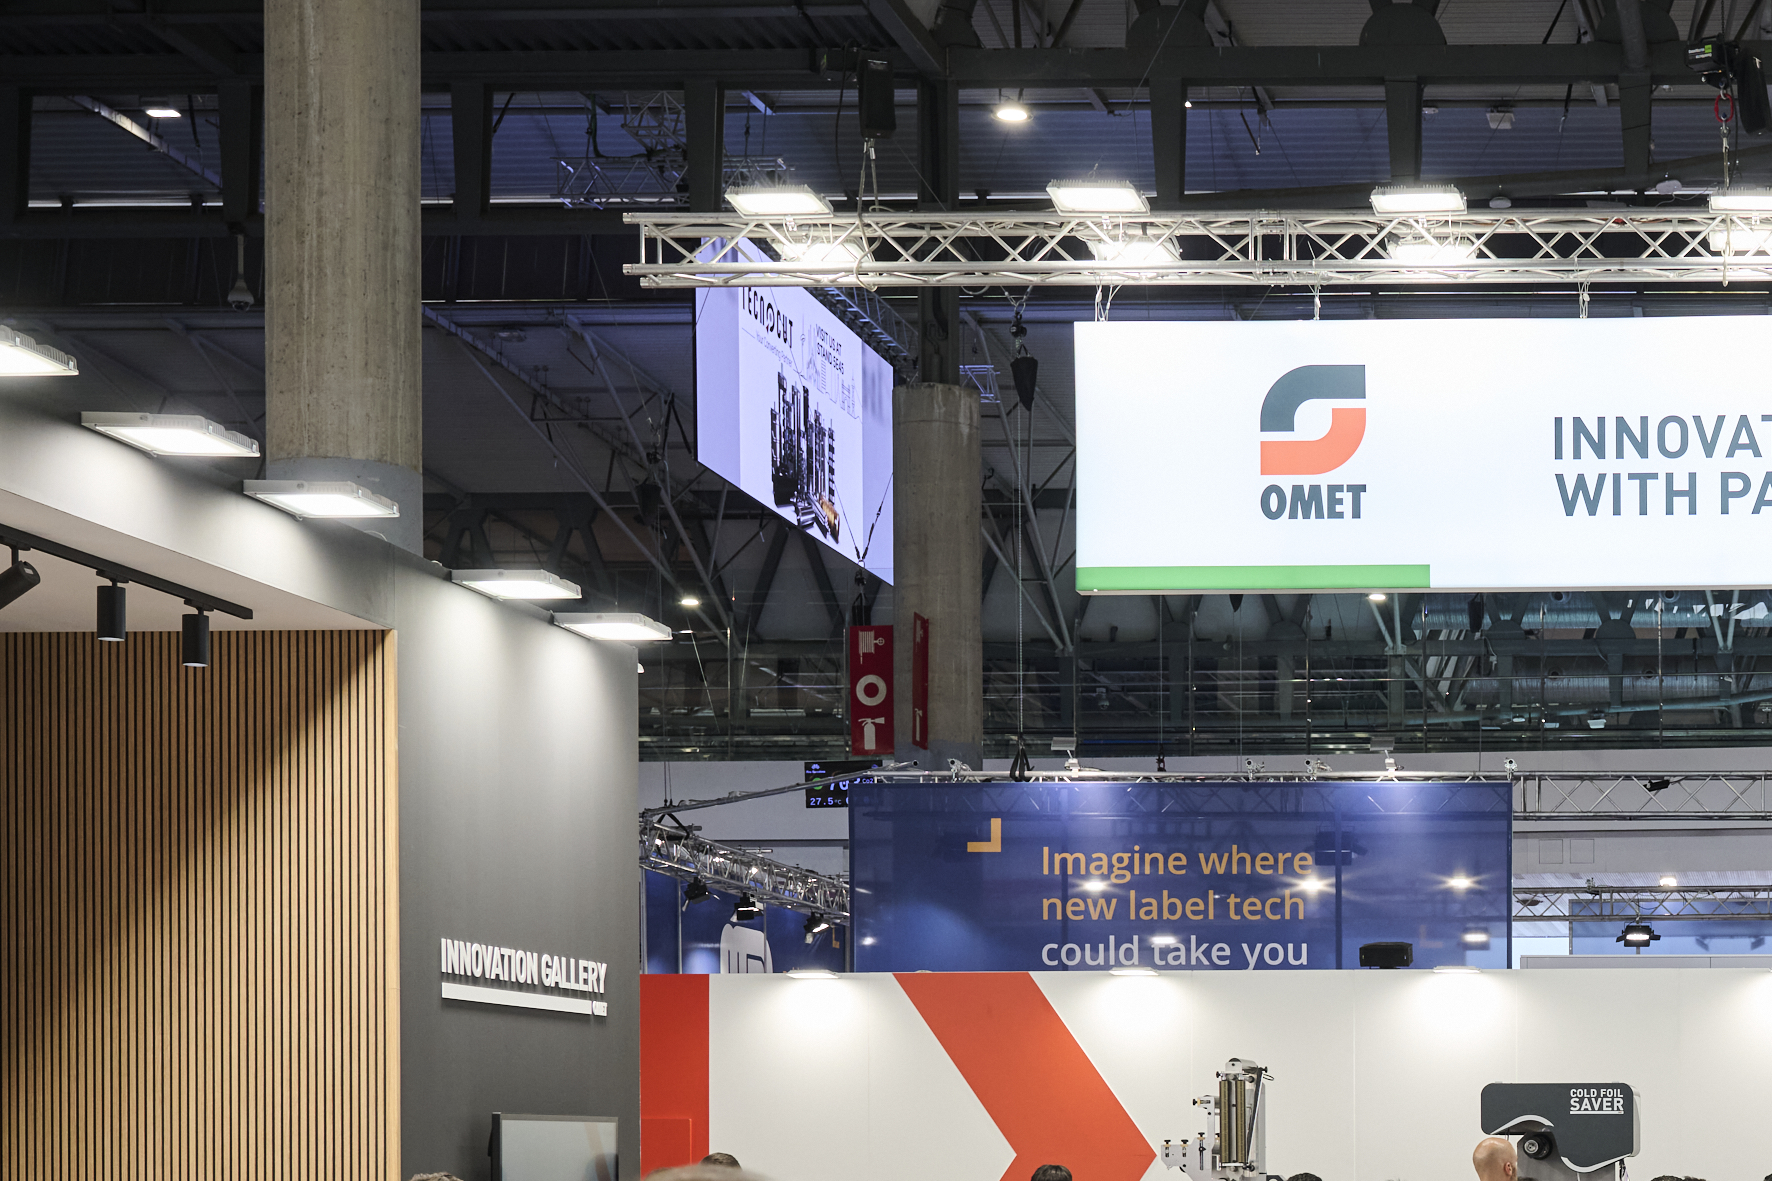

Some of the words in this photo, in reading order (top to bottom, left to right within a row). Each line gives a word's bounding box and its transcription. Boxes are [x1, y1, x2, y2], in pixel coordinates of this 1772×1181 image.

[1261, 484, 1367, 521] OMET
[1555, 471, 1698, 517] WITH
[1043, 845, 1187, 884] Imagine
[1198, 845, 1313, 875] where
[1043, 897, 1117, 920] new
[1130, 890, 1214, 920] label
[1227, 890, 1304, 920] tech
[441, 938, 538, 985] INNOVATION
[541, 954, 607, 994] GALLERY
[1042, 935, 1138, 966] could
[1152, 935, 1230, 966] take
[1242, 942, 1307, 970] you
[1570, 1088, 1597, 1098] COLD
[1600, 1088, 1624, 1098] FOIL
[1570, 1097, 1624, 1111] SAVER
